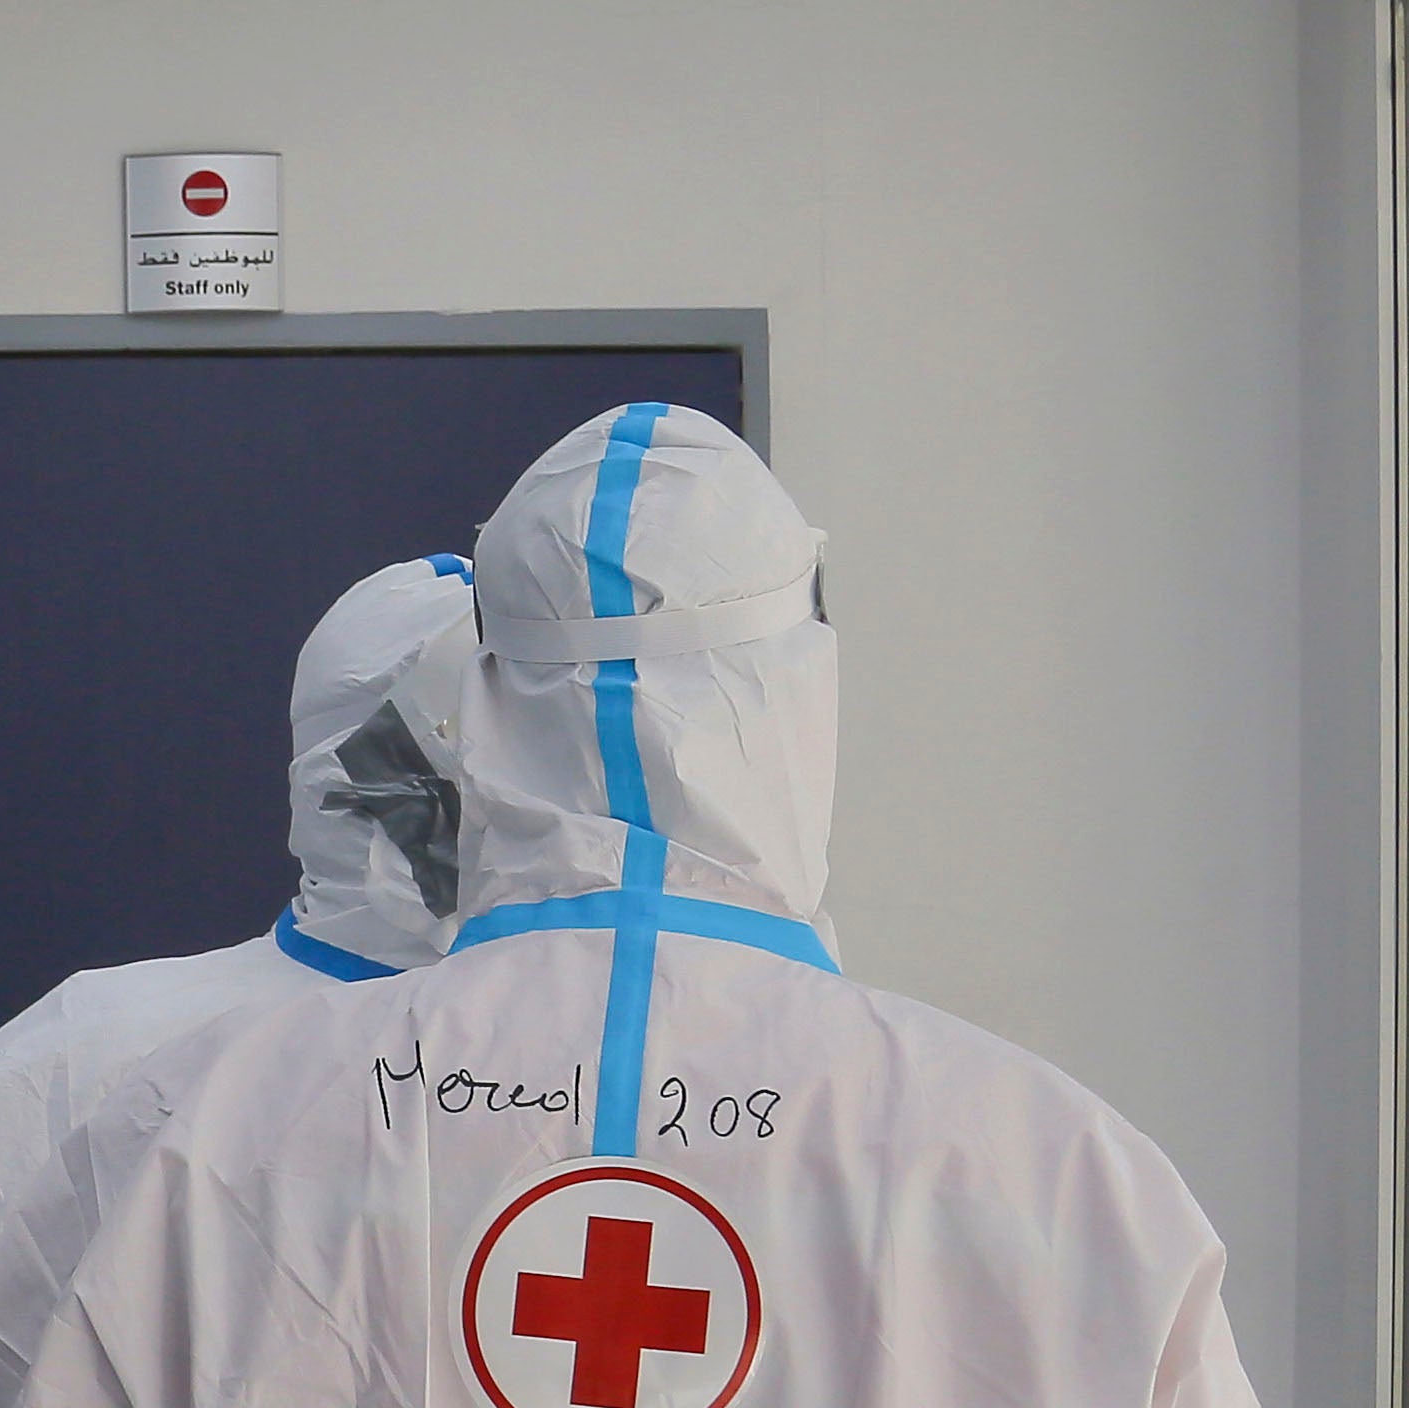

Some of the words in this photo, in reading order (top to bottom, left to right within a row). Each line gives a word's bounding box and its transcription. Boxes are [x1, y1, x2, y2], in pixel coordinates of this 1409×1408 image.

[137, 249, 180, 267] فقط
[190, 249, 274, 270] للموظفين
[165, 280, 208, 295] Staff
[214, 280, 249, 298] only
[658, 1077, 781, 1147] 208
